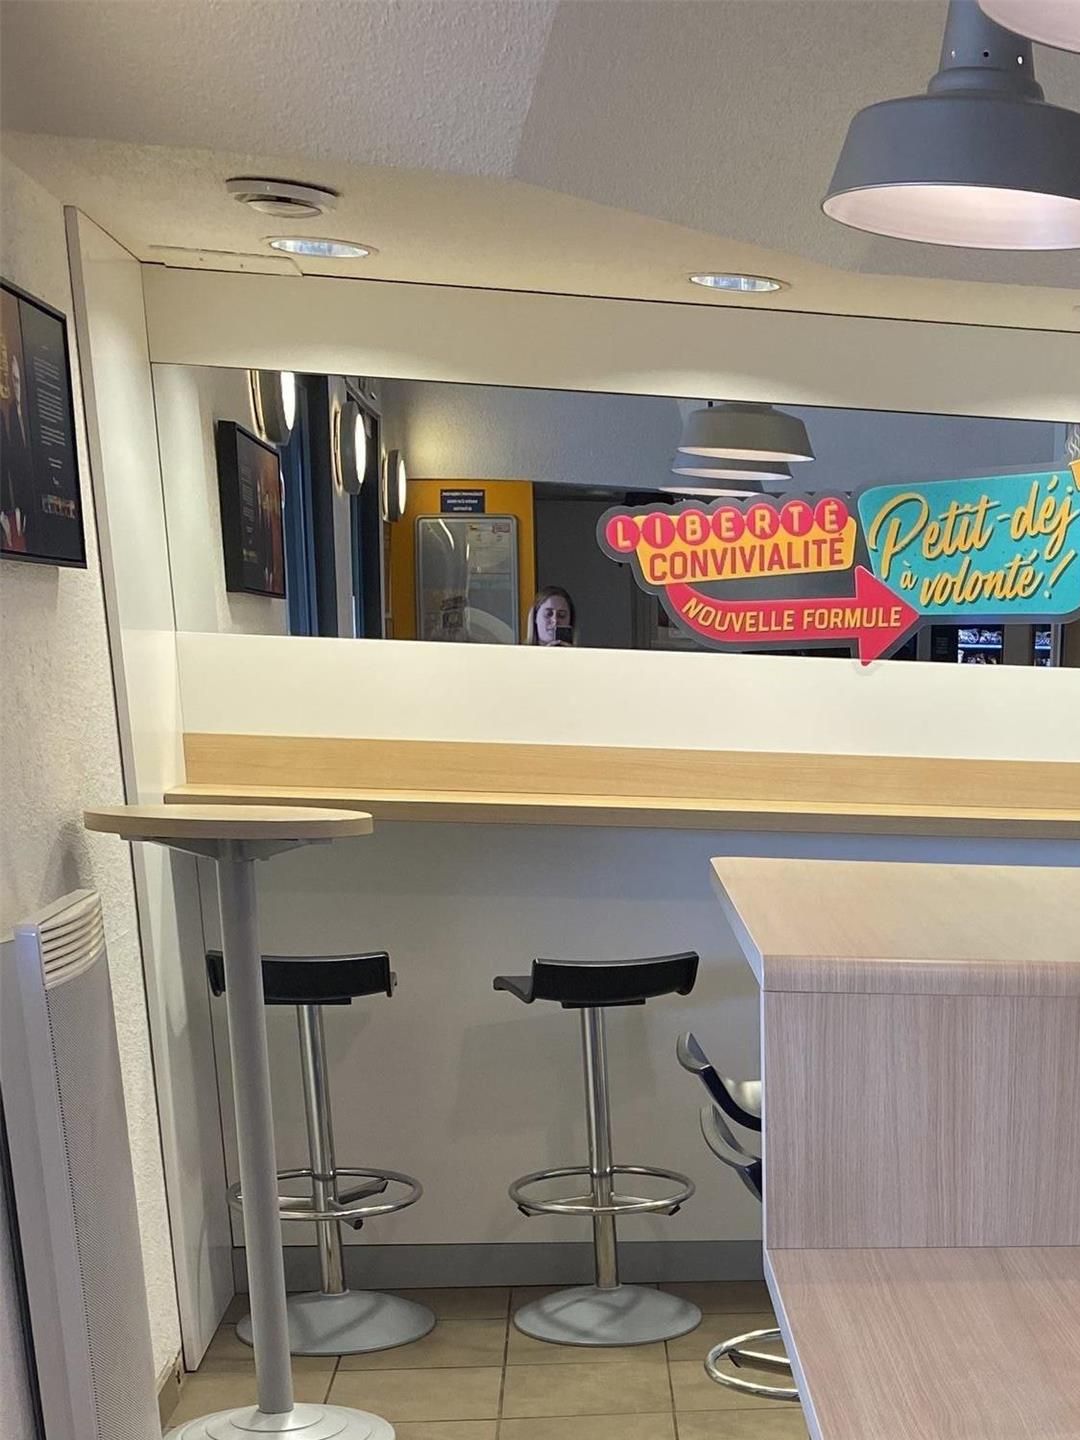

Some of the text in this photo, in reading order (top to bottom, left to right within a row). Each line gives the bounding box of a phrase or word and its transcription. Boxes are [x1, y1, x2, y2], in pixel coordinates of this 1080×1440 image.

[615, 501, 841, 549] LIBERTÉ
[649, 532, 845, 582] CONVIVIALITÉ
[900, 559, 918, 590] à
[681, 598, 903, 633] NOUVELLE FORMULE
